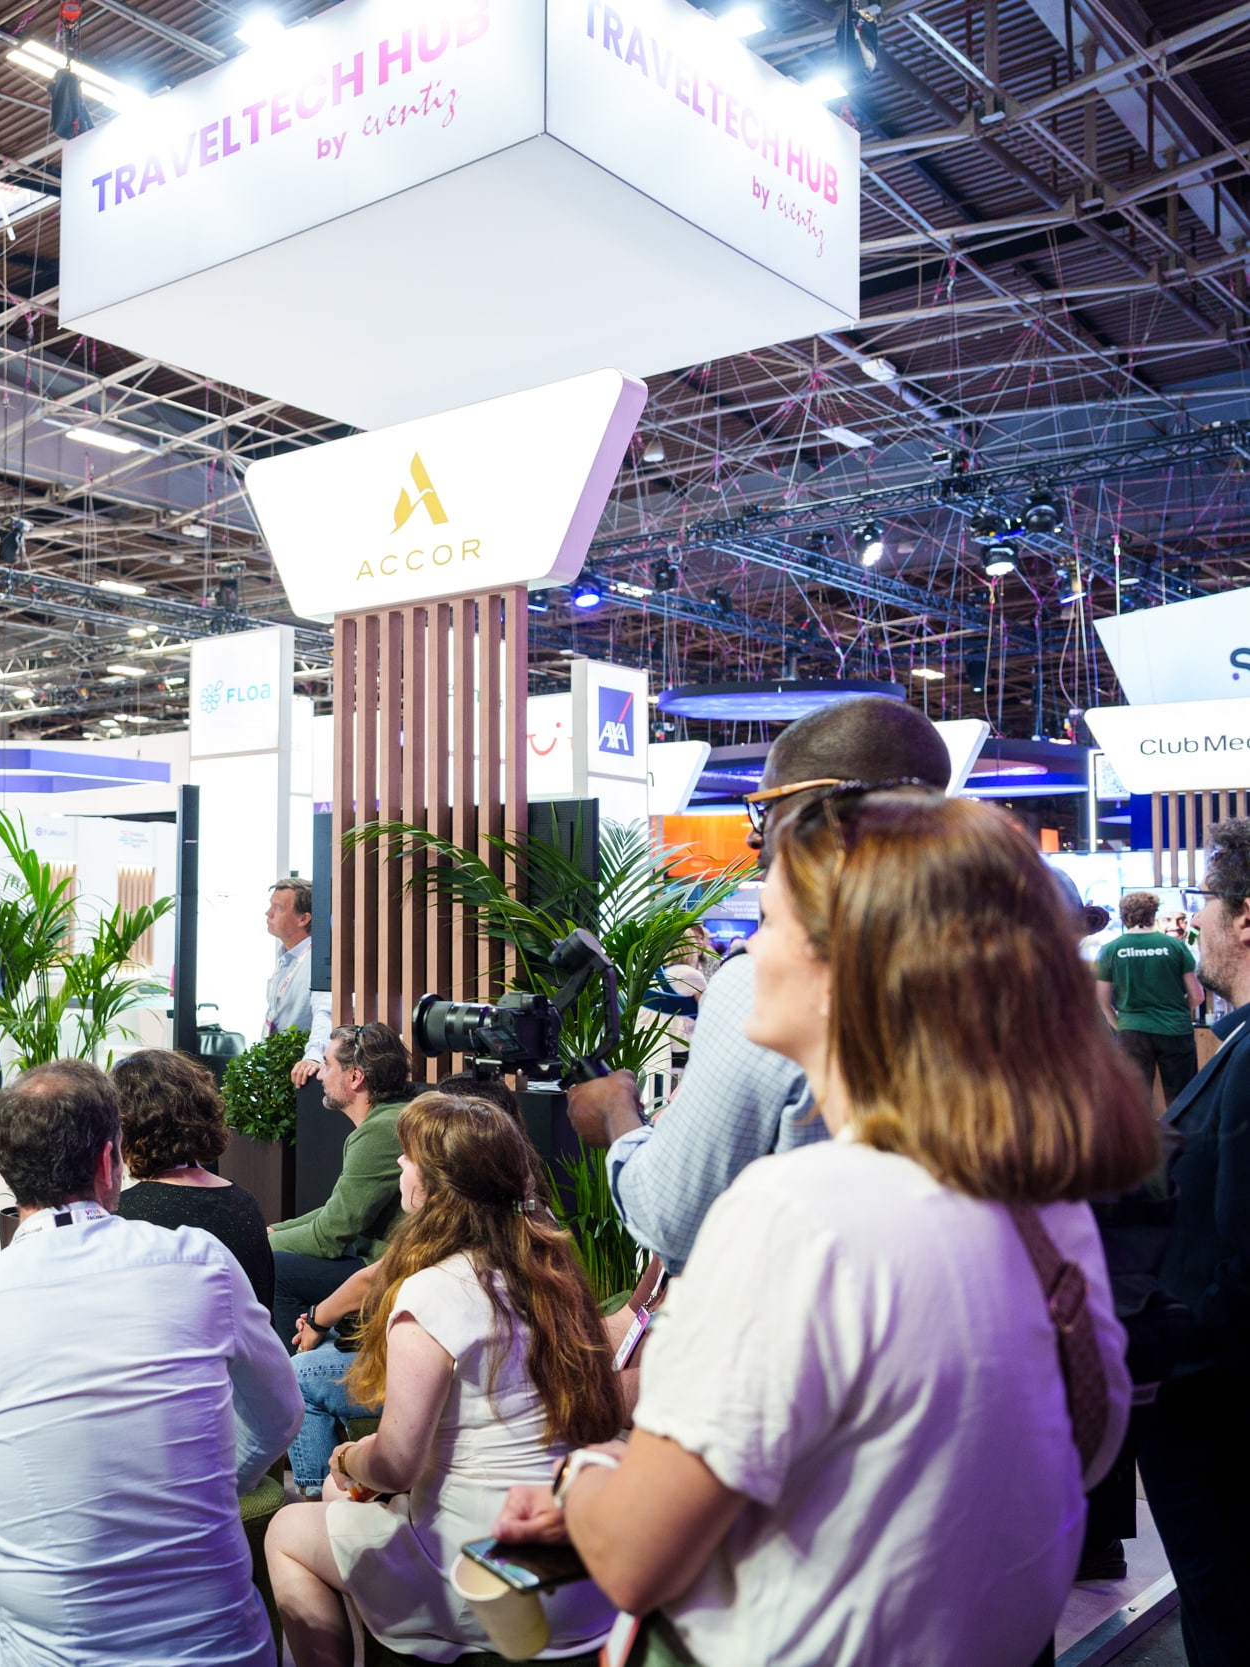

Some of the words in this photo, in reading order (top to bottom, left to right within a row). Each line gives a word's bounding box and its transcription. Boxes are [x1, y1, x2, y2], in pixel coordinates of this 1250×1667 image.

[92, 51, 364, 213] TRAVELTECH
[378, 0, 491, 86] HUB
[317, 131, 348, 160] by
[361, 80, 460, 137] eventiz
[587, 0, 780, 168] TRAVELTECH
[786, 136, 839, 205] HUB
[752, 176, 770, 210] by
[777, 193, 825, 258] eventiz
[355, 538, 482, 583] ACCOR
[599, 721, 630, 751] AXA
[1140, 737, 1199, 756] Club
[1117, 947, 1169, 959] Climeet
